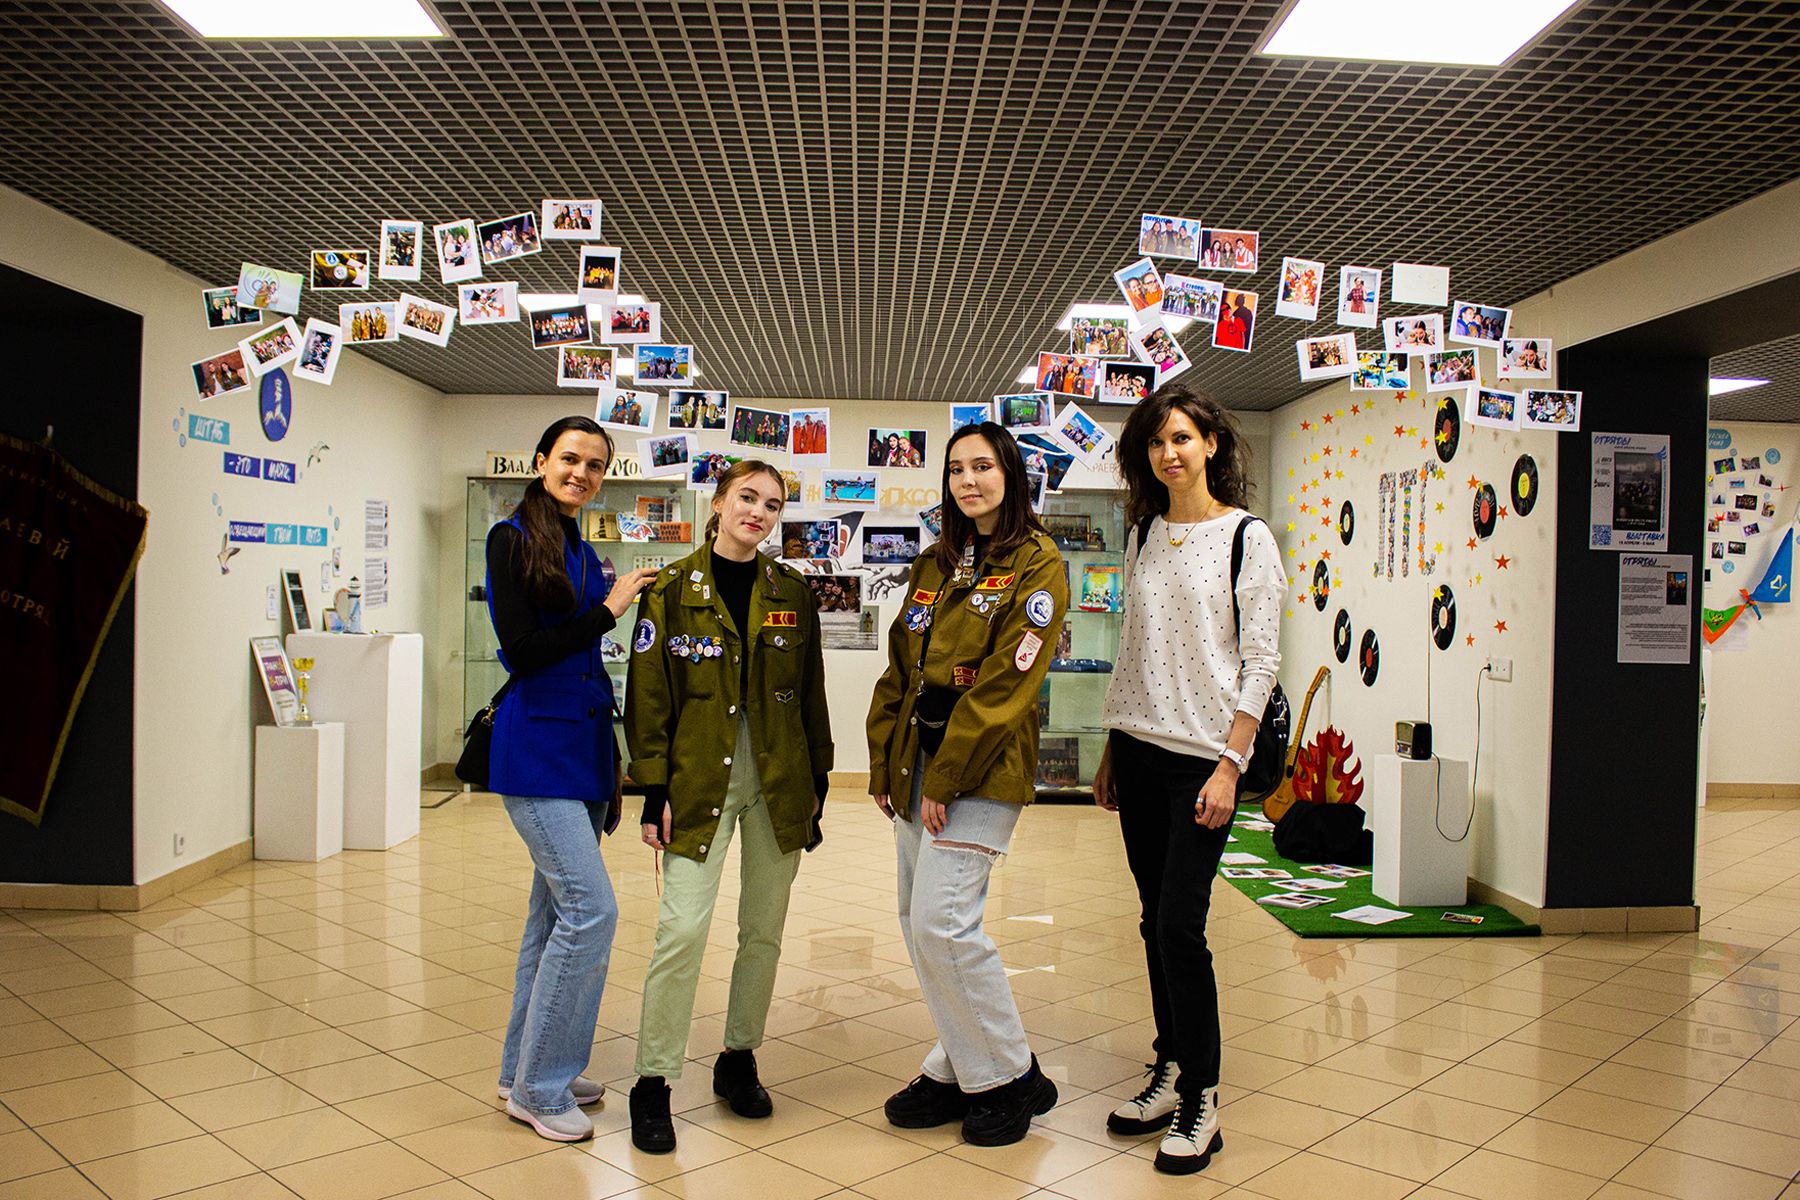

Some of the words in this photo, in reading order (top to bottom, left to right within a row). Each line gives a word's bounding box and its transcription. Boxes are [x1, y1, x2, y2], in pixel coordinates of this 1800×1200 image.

[194, 416, 225, 441] ШТАБ
[1594, 435, 1631, 446] ОТРЯДЫ
[273, 524, 292, 543] ТВОЙ
[1626, 532, 1664, 541] ВЫСТАВКА
[1623, 557, 1657, 566] ОТРЯДЫ
